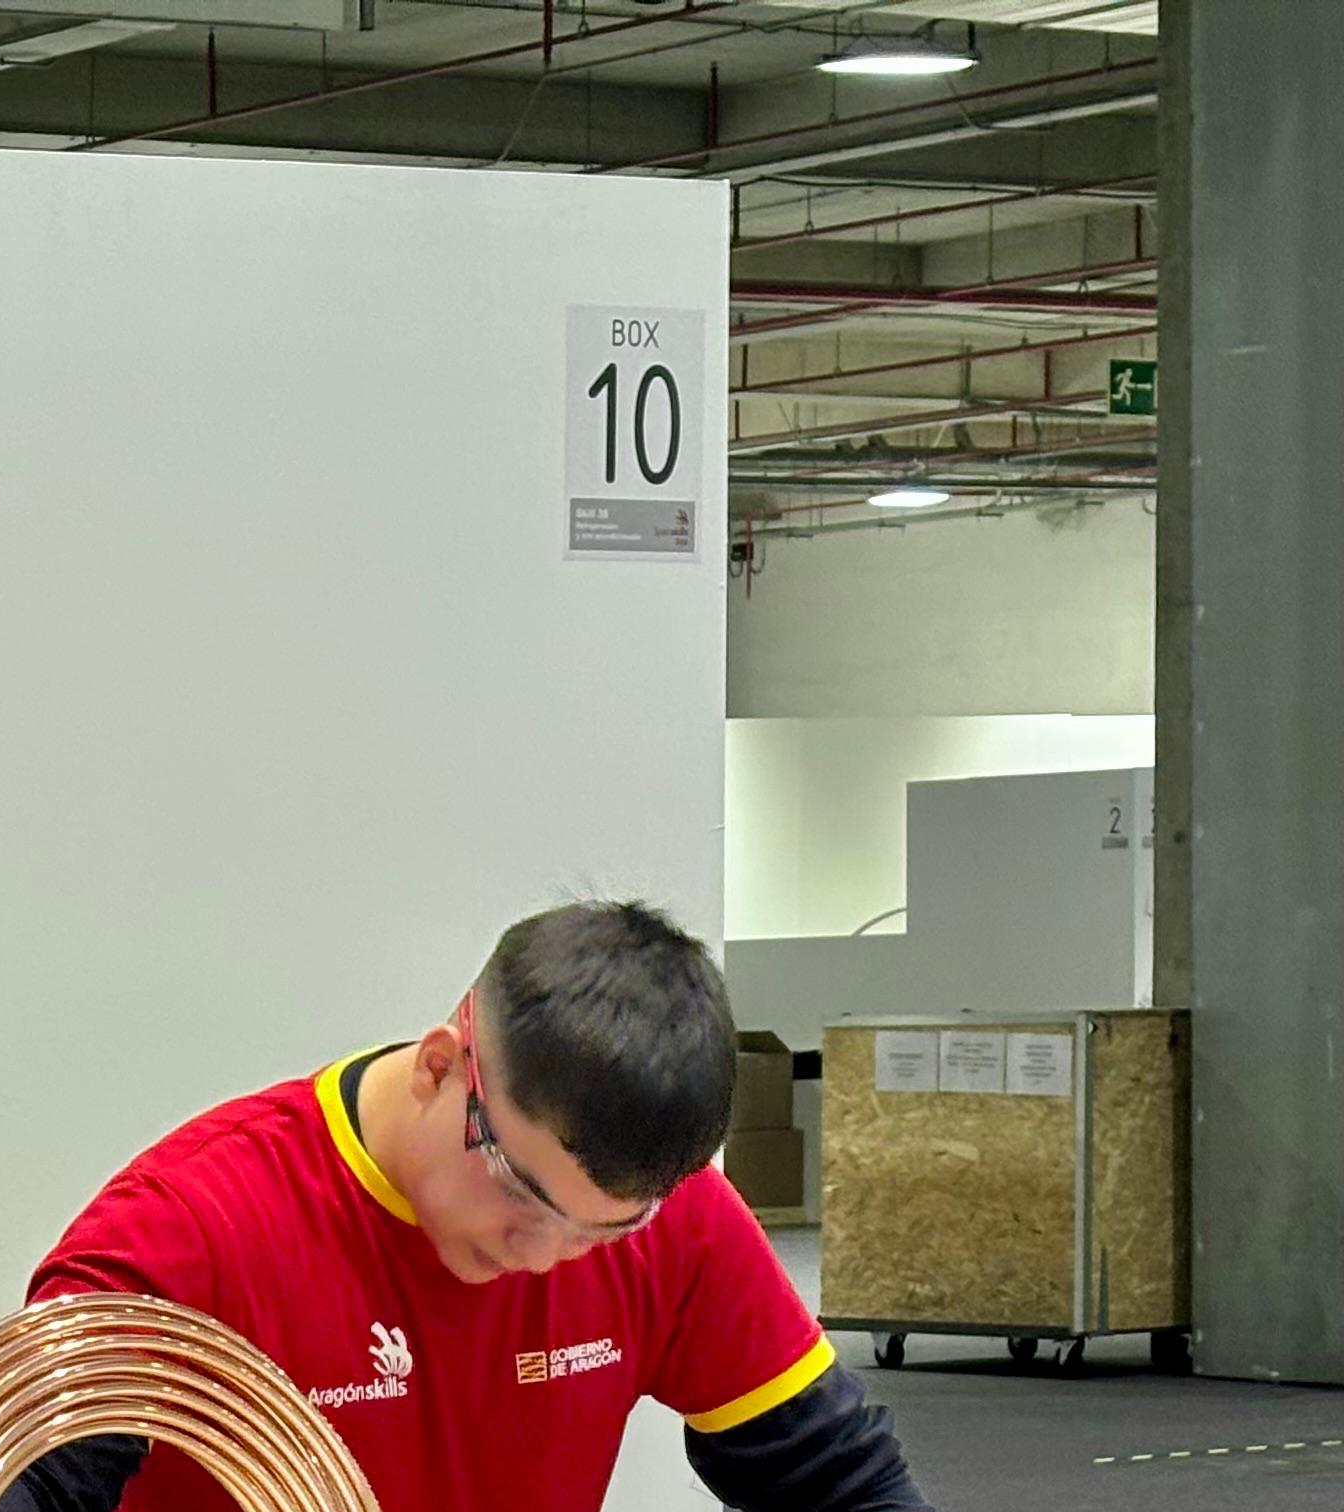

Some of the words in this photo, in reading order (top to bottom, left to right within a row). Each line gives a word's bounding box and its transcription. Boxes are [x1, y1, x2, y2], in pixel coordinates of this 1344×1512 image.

[612, 319, 660, 348] BOX
[588, 362, 681, 485] 10
[1110, 806, 1121, 834] 2
[549, 1338, 612, 1364] GOBIERNO
[550, 1362, 568, 1380] DE
